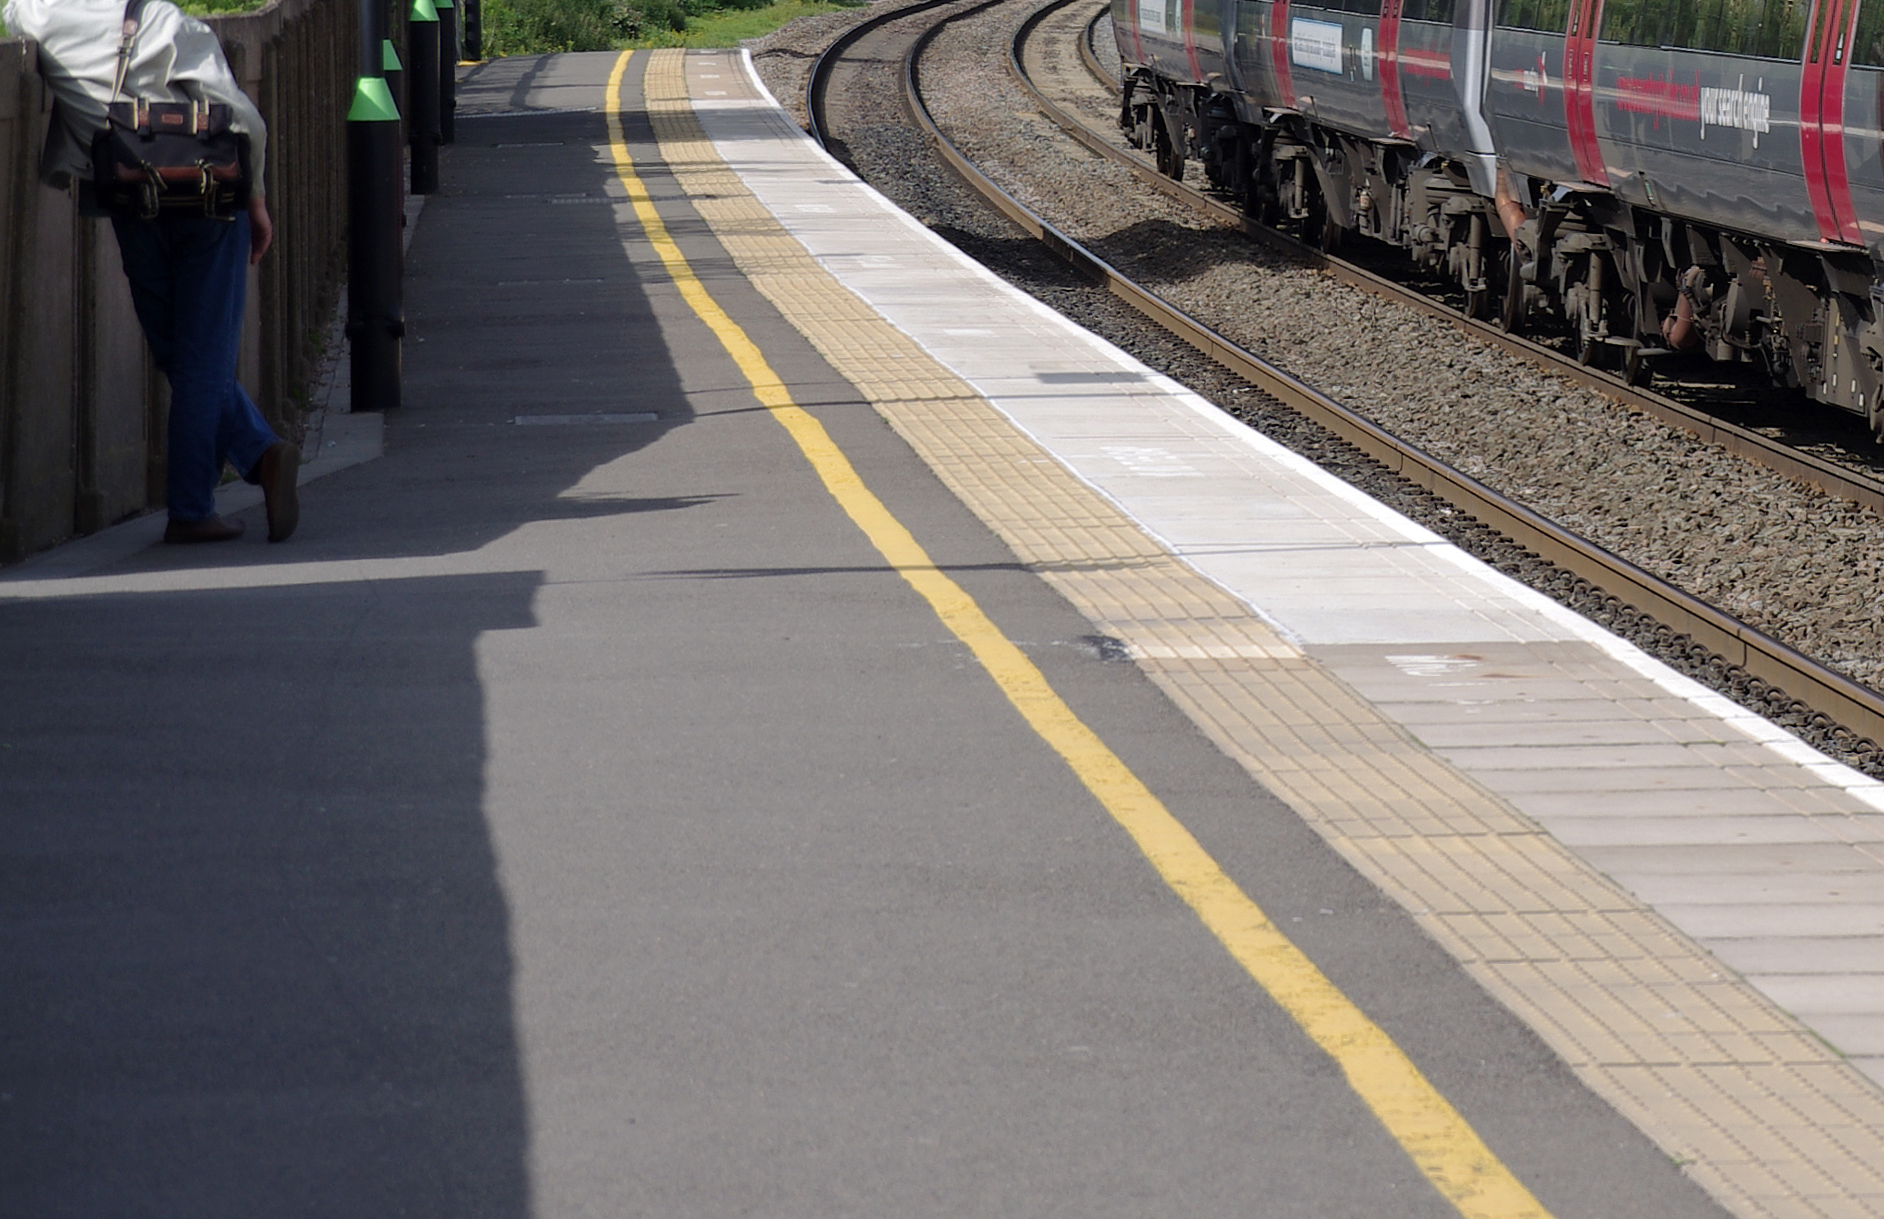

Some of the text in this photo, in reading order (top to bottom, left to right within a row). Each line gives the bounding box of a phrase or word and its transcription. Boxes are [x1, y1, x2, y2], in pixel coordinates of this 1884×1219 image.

[1700, 86, 1719, 140] your
[1718, 73, 1743, 128] search
[1743, 76, 1770, 149] engine
